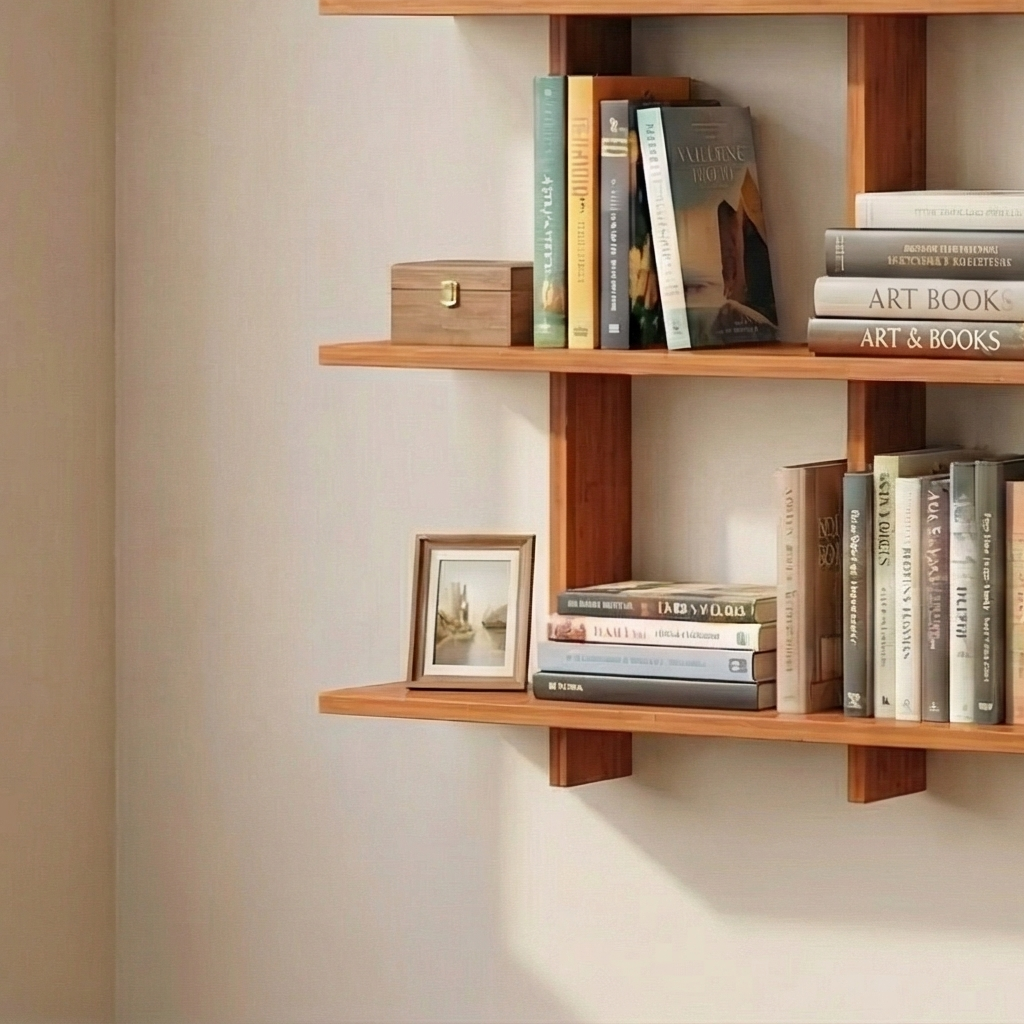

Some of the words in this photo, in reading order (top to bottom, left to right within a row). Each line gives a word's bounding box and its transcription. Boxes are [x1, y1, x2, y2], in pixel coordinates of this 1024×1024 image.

[868, 287, 919, 310] ART
[860, 327, 901, 349] ART
[906, 327, 923, 349] &
[929, 328, 1001, 352] BOOKS
